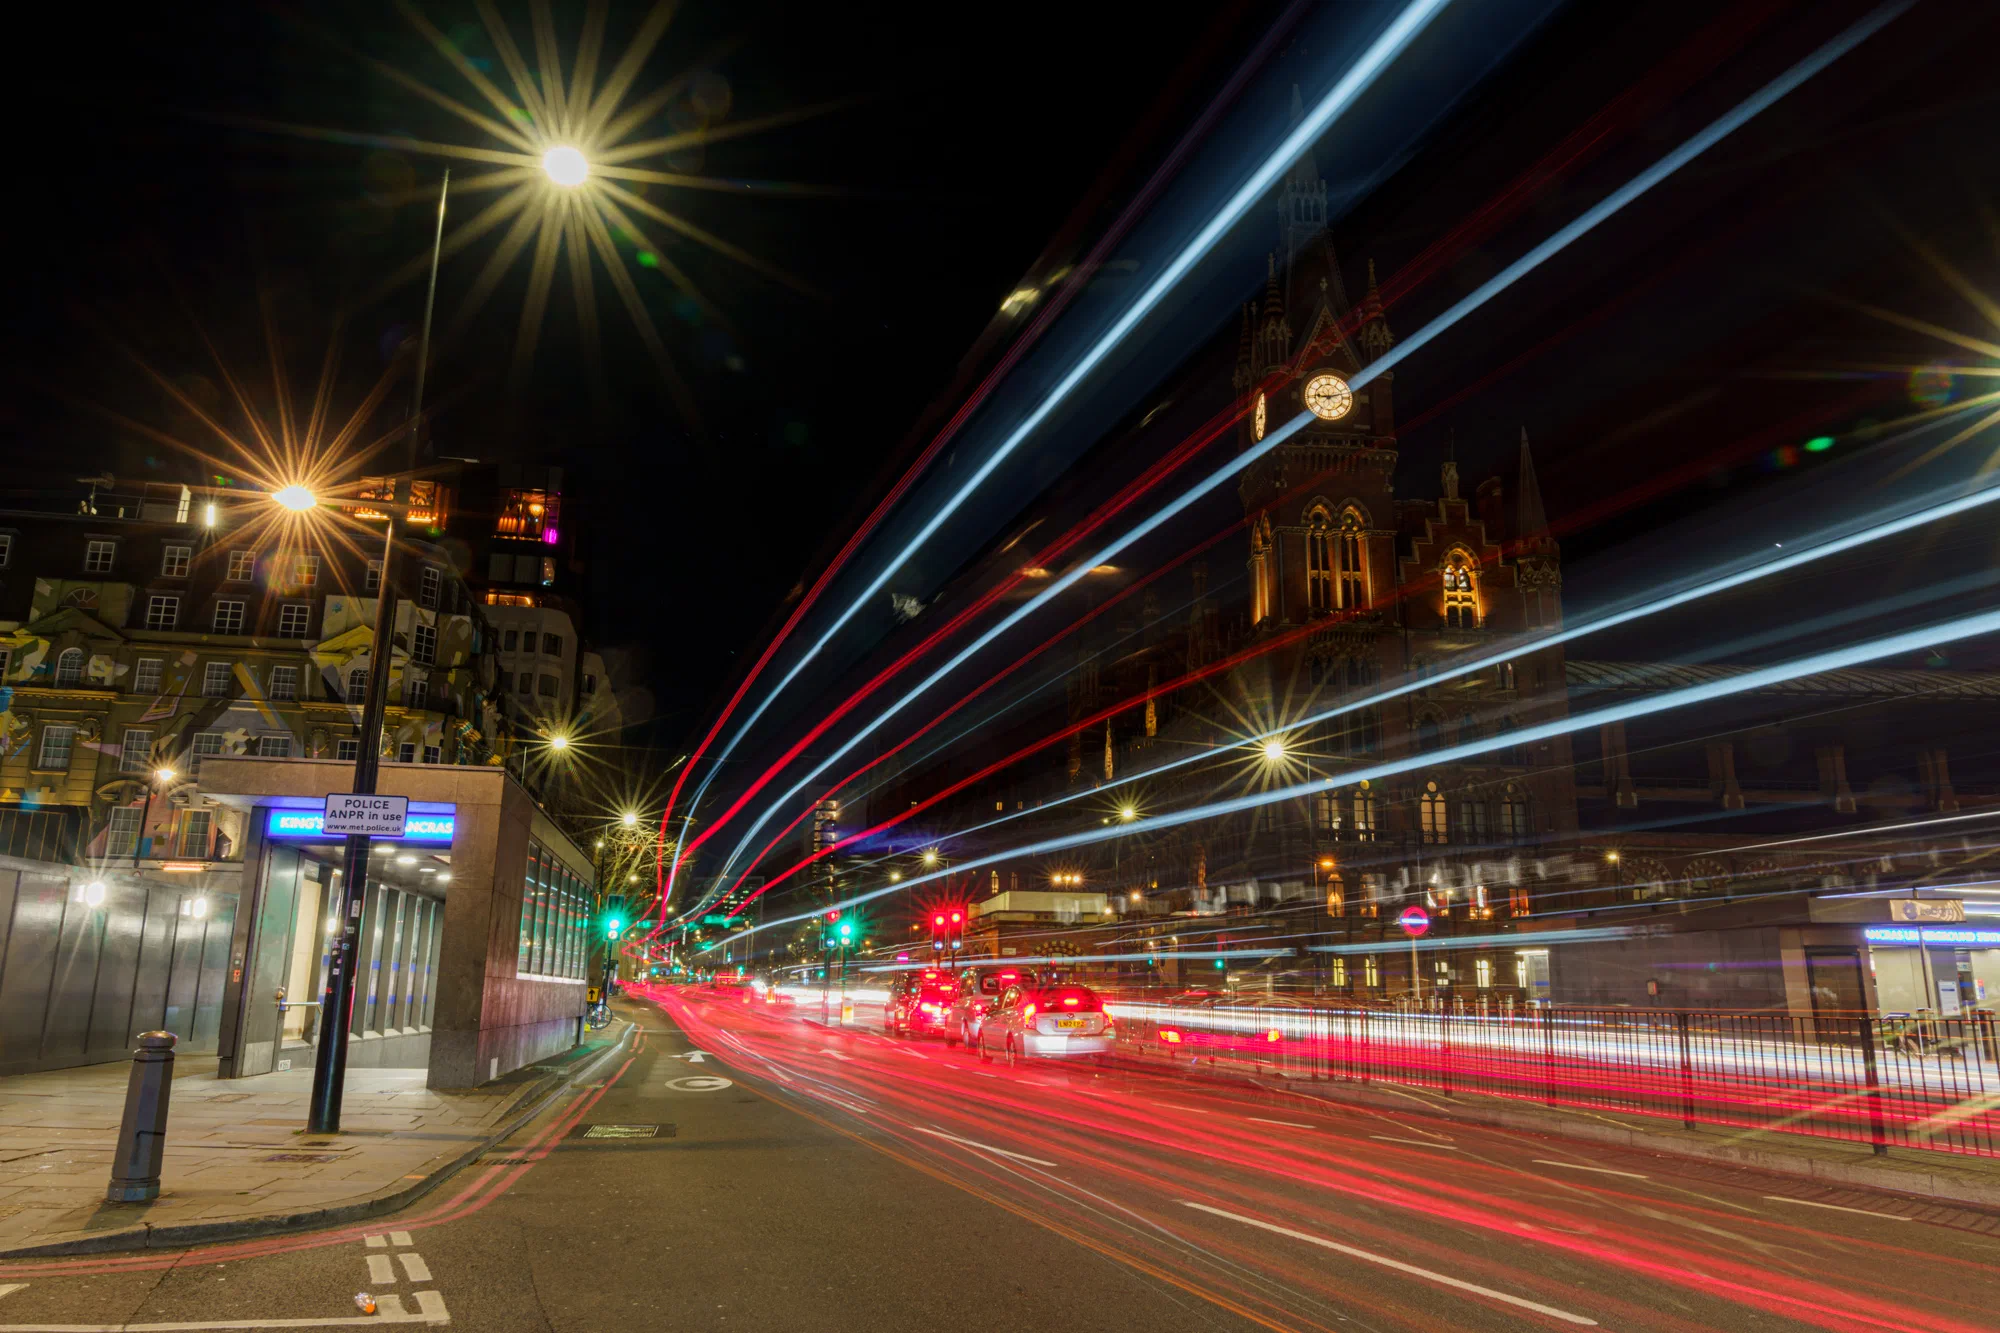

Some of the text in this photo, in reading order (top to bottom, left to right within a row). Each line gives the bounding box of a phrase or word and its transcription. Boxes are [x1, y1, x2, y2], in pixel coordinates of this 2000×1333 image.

[345, 799, 389, 809] POLICE
[329, 810, 402, 821] ANPR in use
[327, 824, 401, 832] www.met.police.uk
